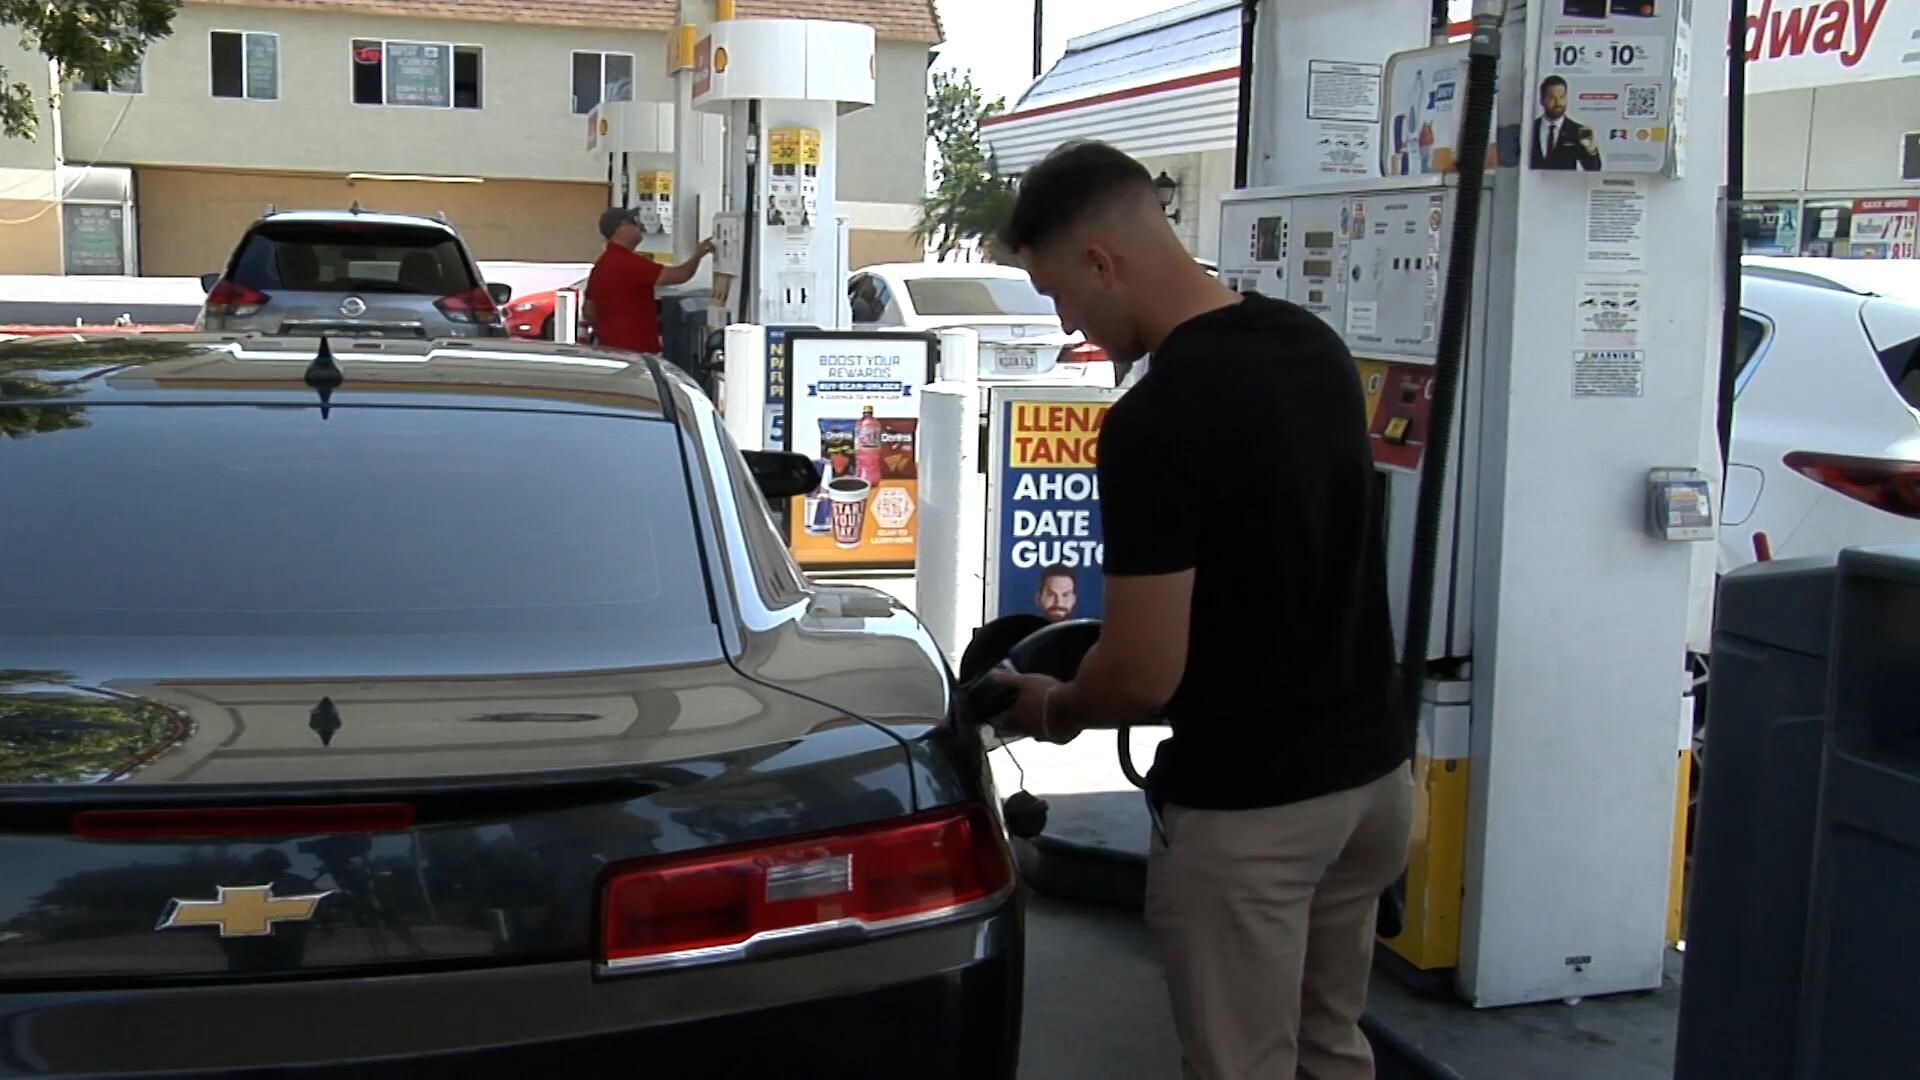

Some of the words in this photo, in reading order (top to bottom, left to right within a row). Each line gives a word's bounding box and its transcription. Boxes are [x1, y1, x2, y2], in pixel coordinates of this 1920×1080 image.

[819, 355, 863, 366] BOOST
[866, 355, 900, 366] YOUR
[828, 367, 891, 378] REWARDS
[1017, 405, 1107, 432] LLENA
[1013, 510, 1090, 537] DATE
